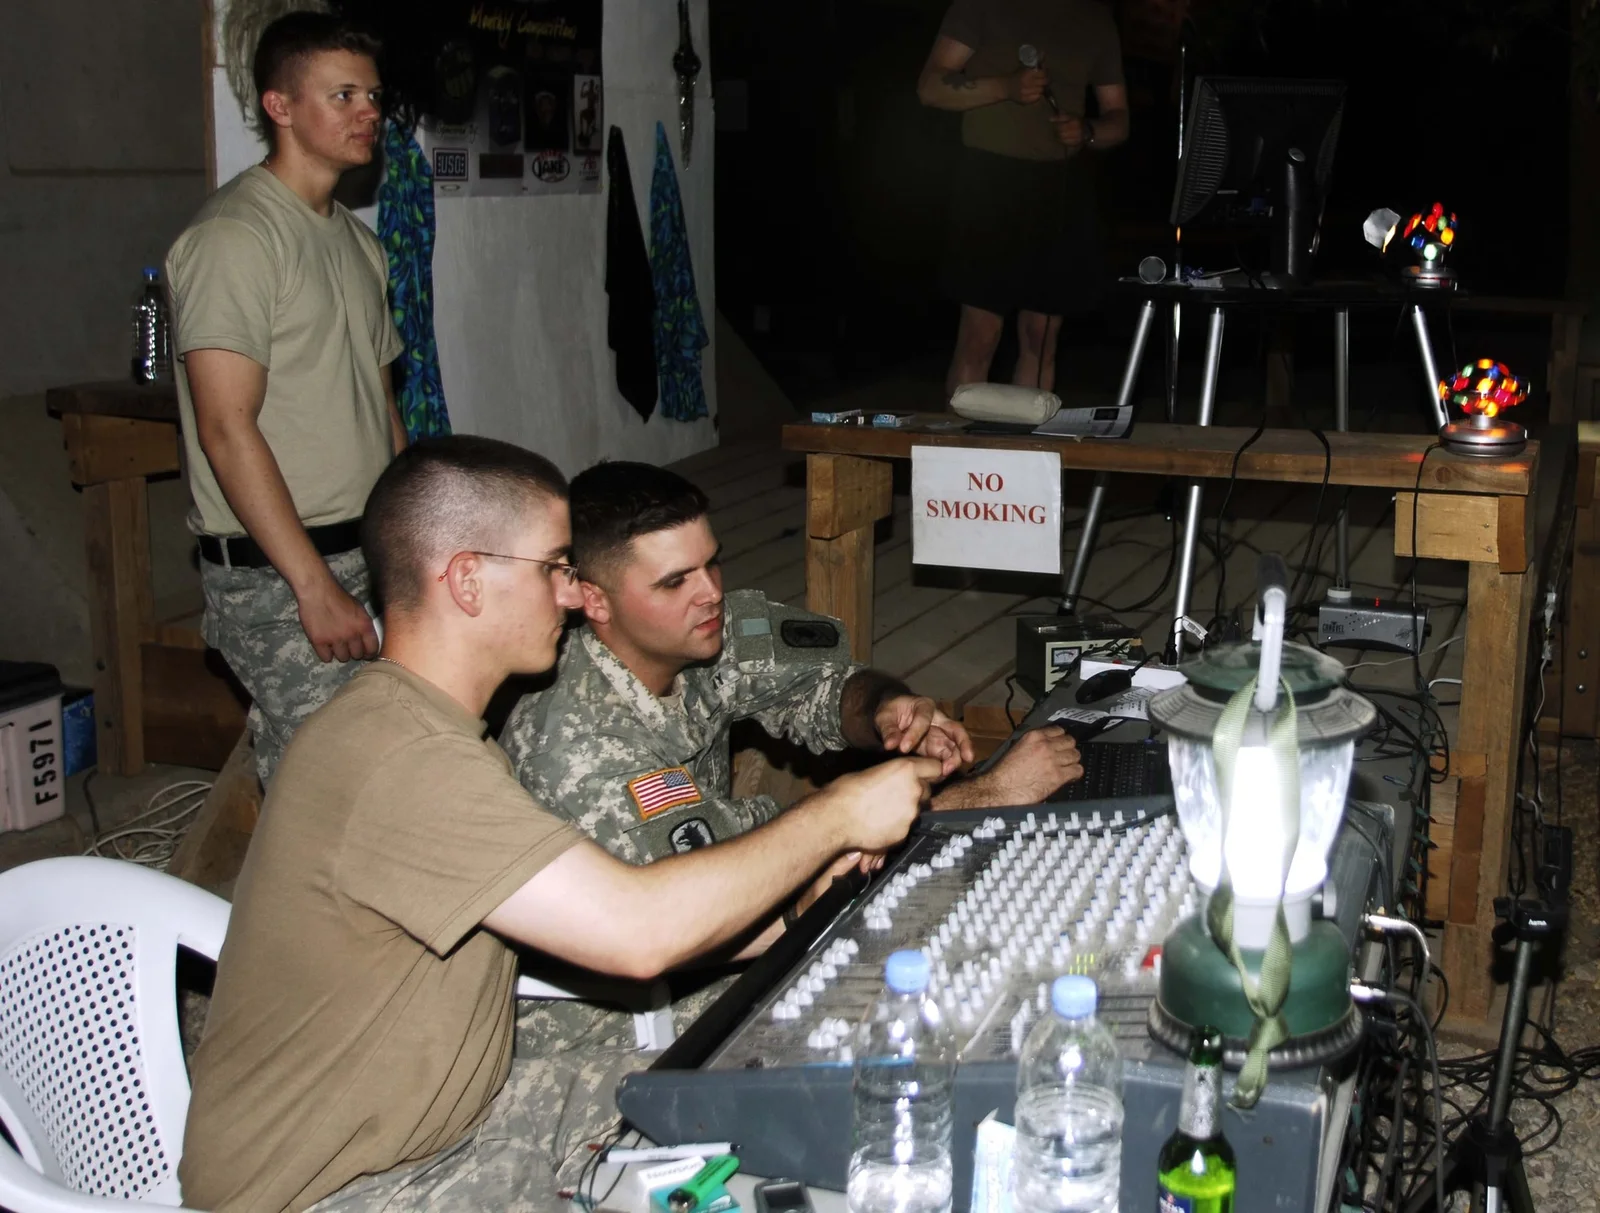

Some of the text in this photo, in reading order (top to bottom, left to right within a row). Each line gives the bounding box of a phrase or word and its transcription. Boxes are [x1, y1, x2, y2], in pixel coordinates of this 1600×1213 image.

[441, 155, 461, 174] USO
[967, 472, 1004, 492] NO
[926, 499, 1046, 525] SMOKING
